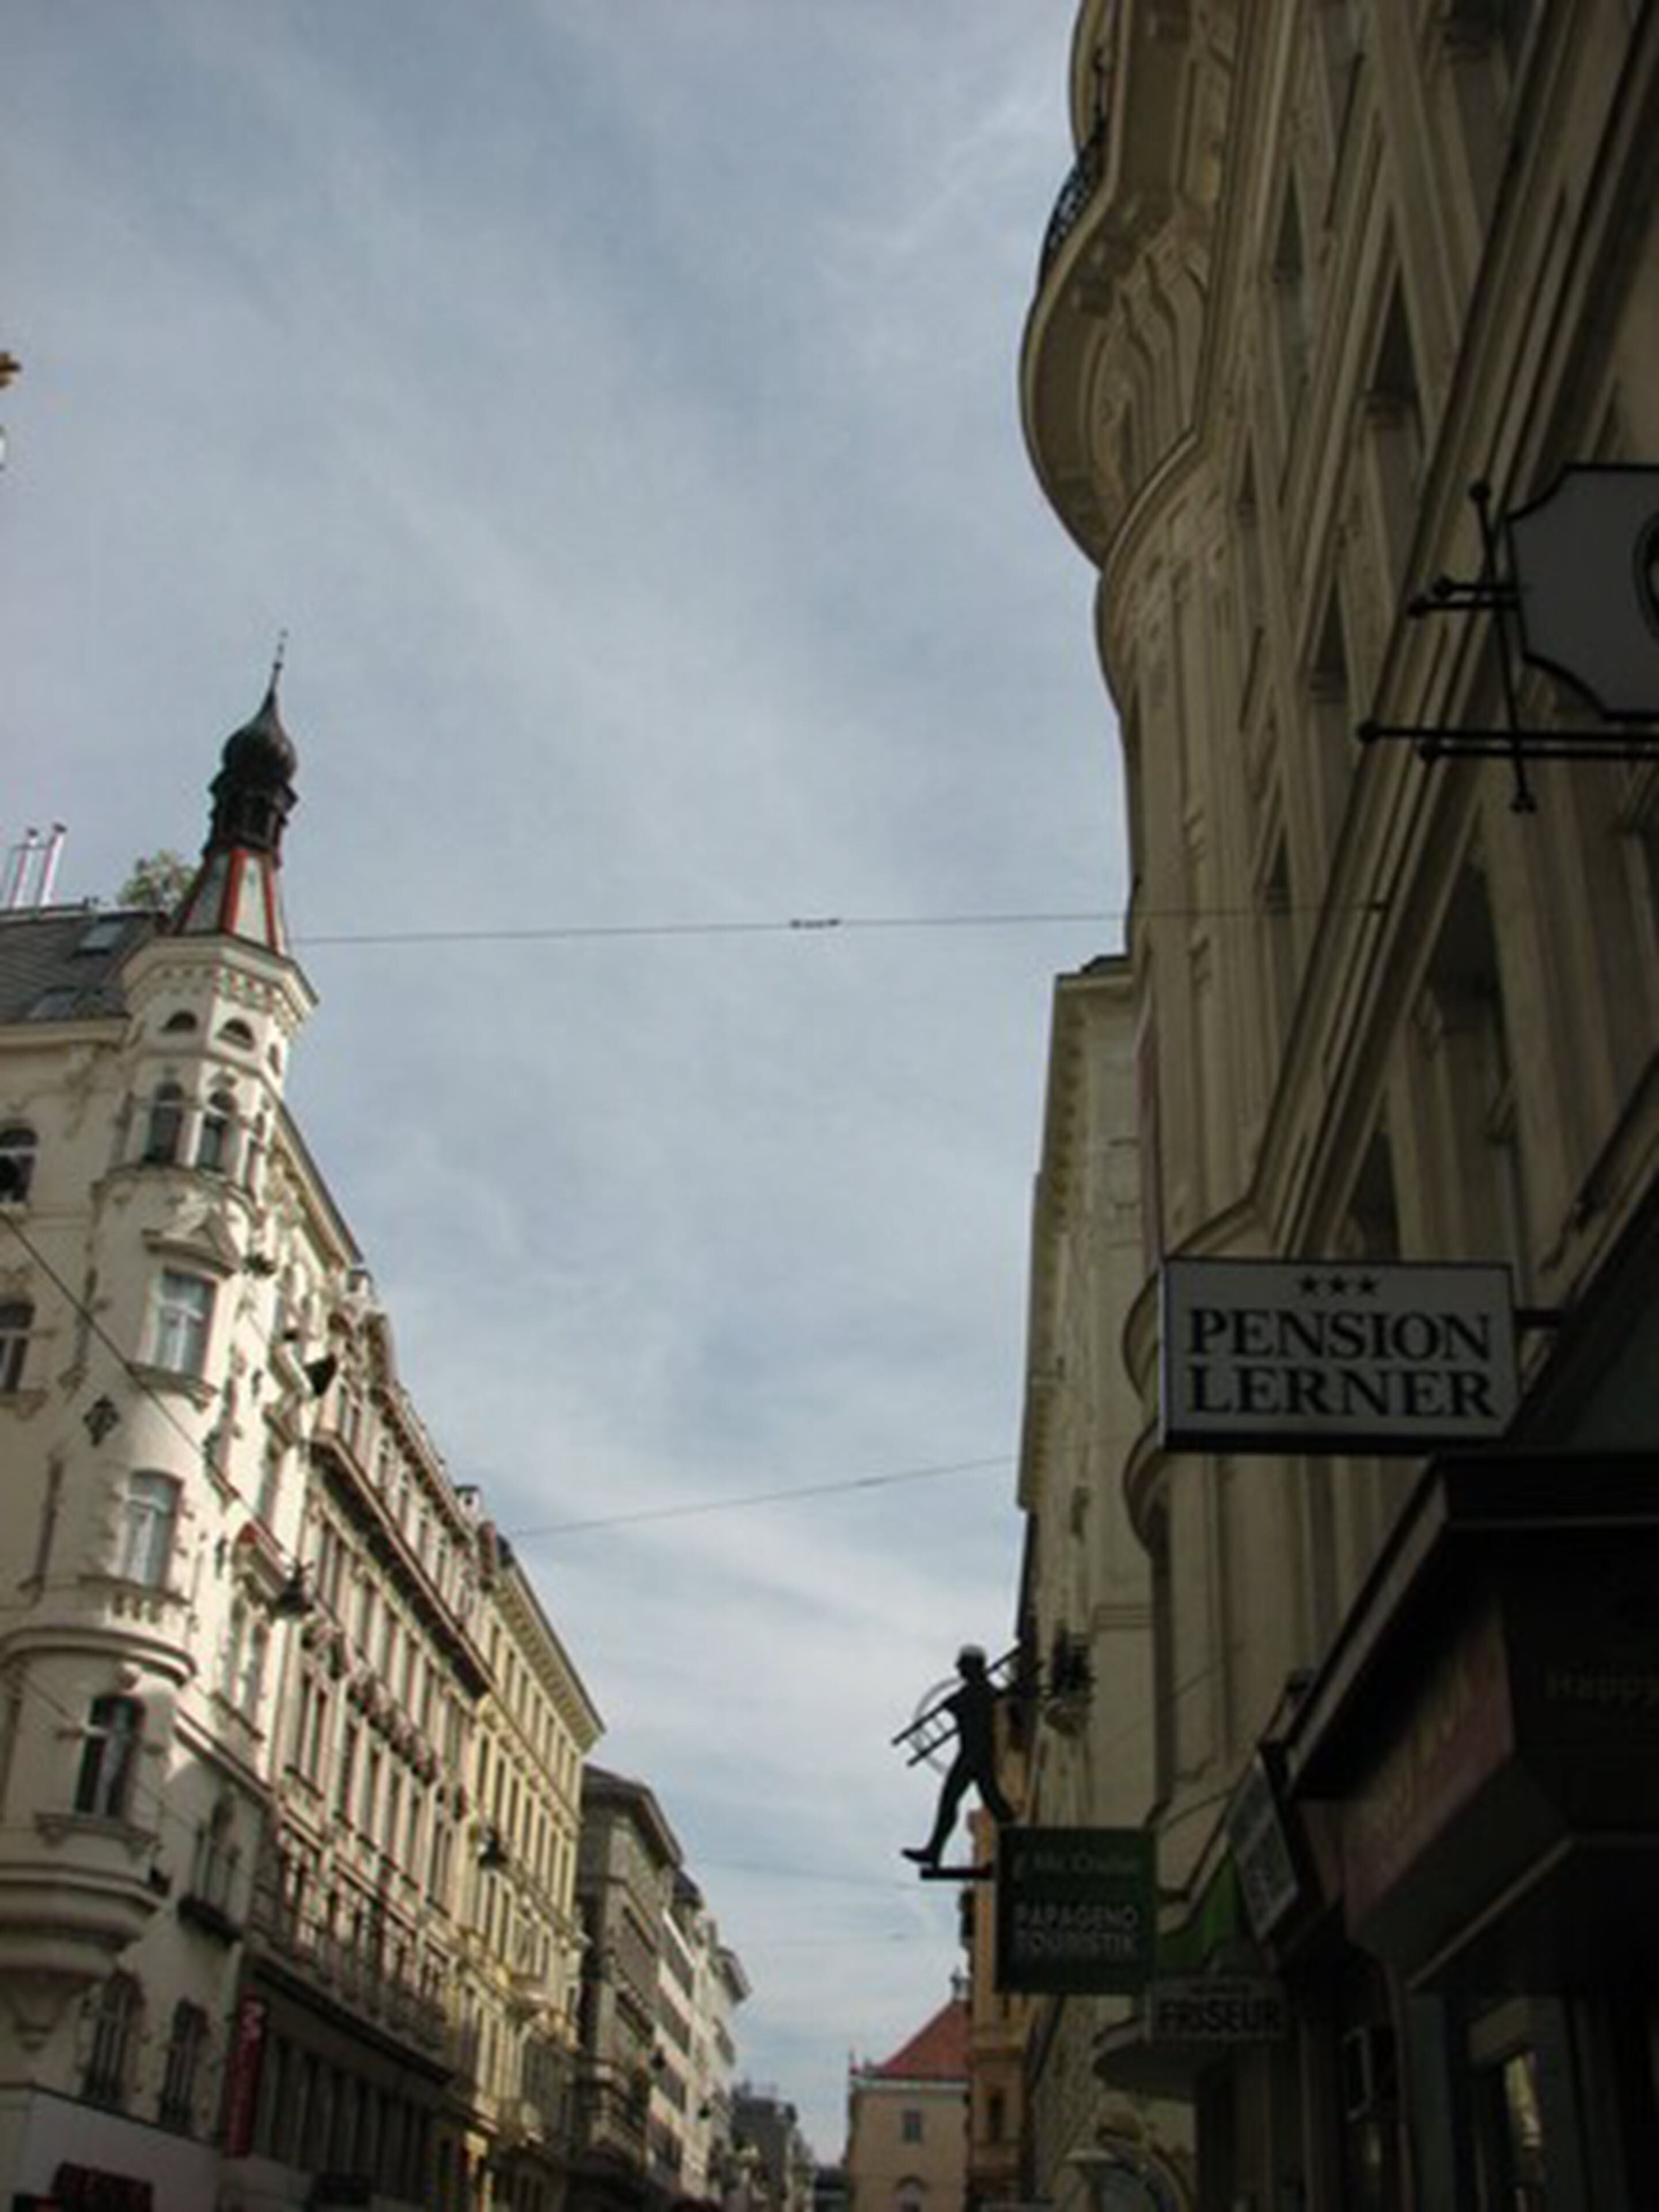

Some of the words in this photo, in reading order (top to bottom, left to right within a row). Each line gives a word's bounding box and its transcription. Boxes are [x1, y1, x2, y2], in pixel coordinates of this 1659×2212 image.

[1189, 1309, 1491, 1362] PENSION
[1189, 1365, 1496, 1418] LERNER
[1014, 1904, 1139, 1929] PAPAGENO
[1013, 1931, 1139, 1957] TOURISTIK
[1160, 1999, 1281, 2032] FRISEUR
